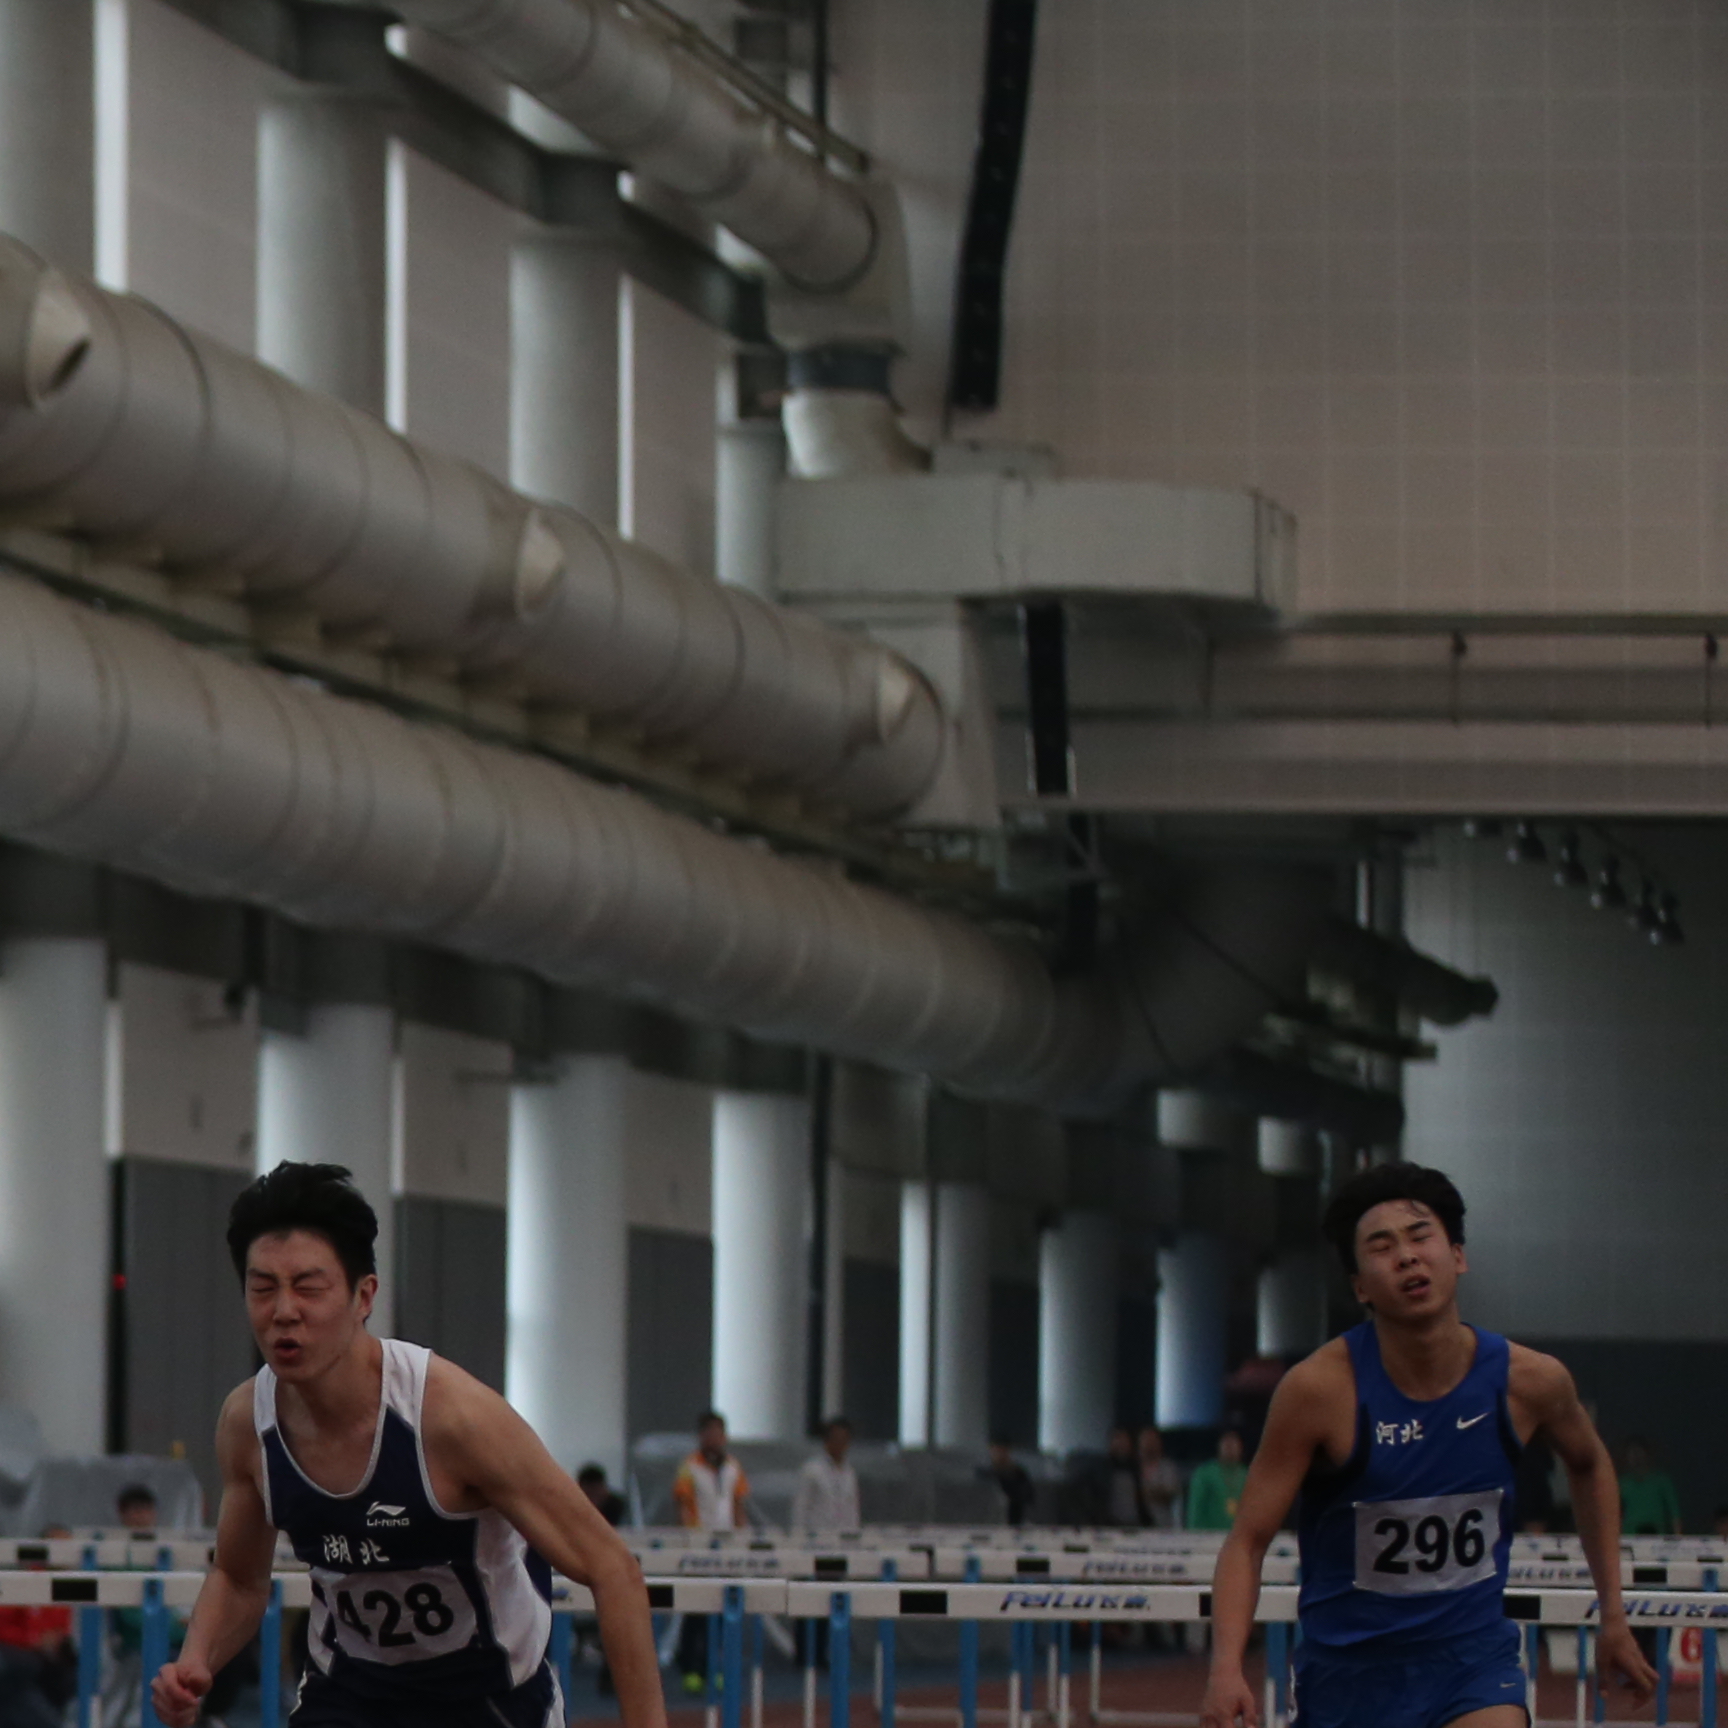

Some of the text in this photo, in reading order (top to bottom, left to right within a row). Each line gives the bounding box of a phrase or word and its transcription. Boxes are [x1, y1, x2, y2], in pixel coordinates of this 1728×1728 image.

[1375, 1418, 1425, 1446] 河北
[366, 1517, 411, 1528] LI-NING
[322, 1534, 390, 1566] 湖北
[1372, 1508, 1485, 1575] 296
[337, 1582, 454, 1648] 428
